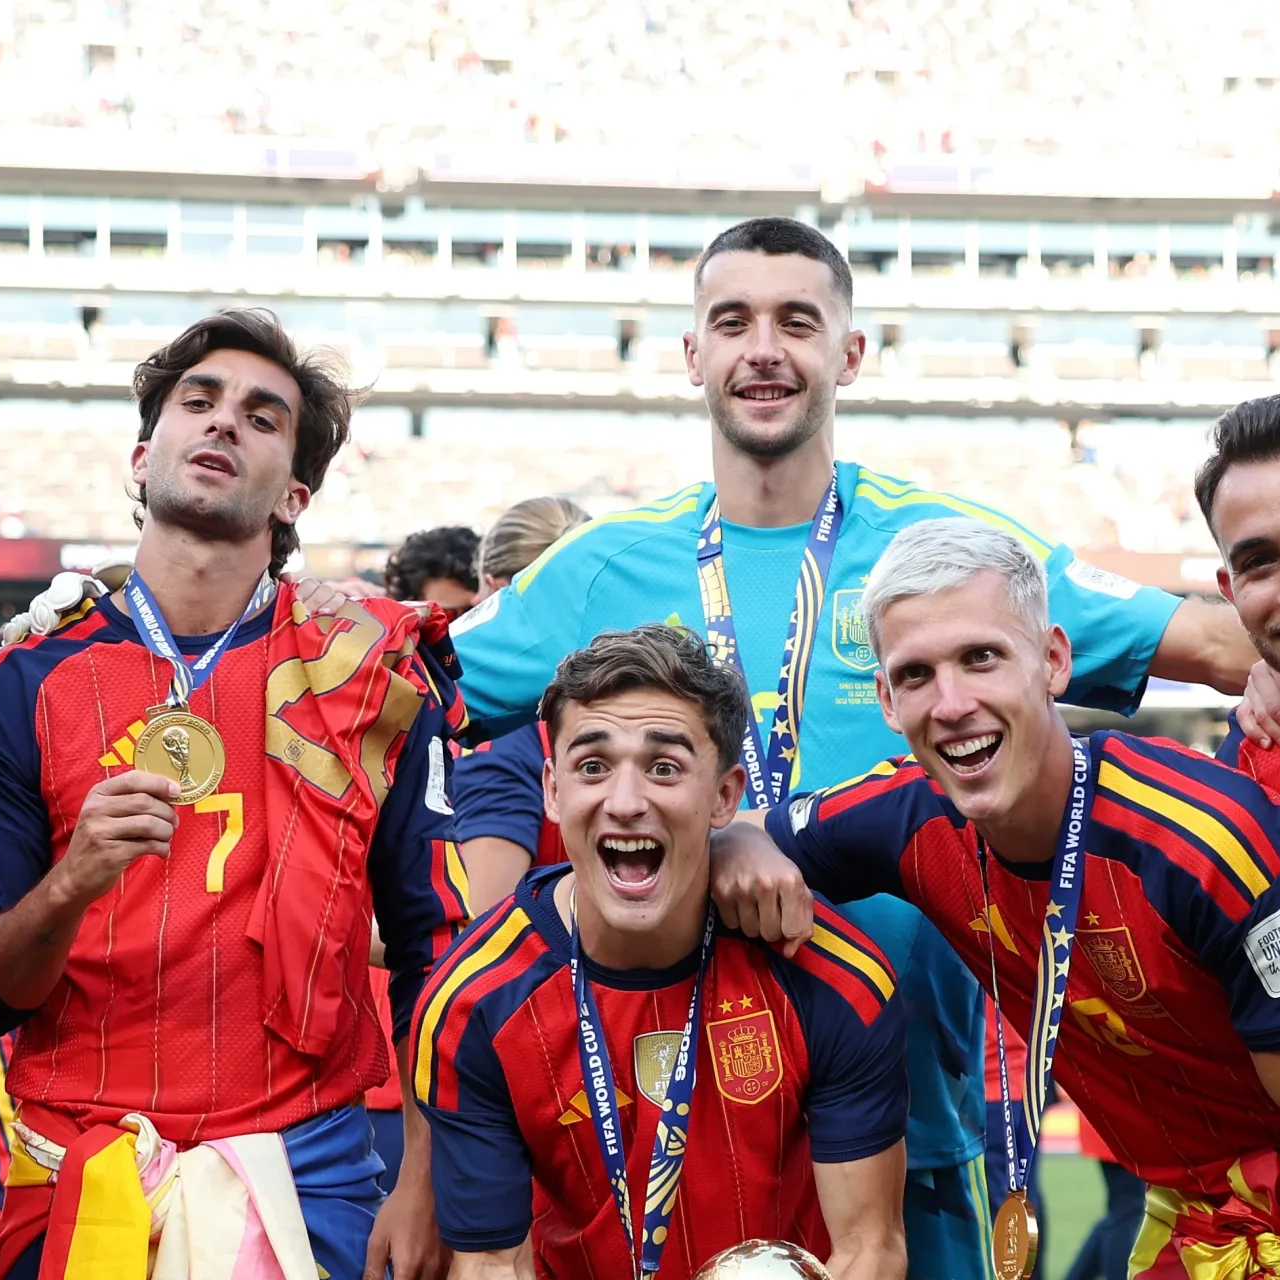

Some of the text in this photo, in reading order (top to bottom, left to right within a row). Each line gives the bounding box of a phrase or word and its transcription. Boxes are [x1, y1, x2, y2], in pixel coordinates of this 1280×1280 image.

[815, 513, 832, 542] FIFA
[131, 586, 144, 607] FIFA
[138, 604, 159, 630] WORLD
[742, 738, 766, 792] WORLD
[1074, 749, 1088, 784] CUP
[1066, 786, 1085, 849] WORLD
[194, 793, 244, 893] 7
[1060, 851, 1077, 889] FIFA
[580, 1020, 598, 1054] CUP
[675, 1022, 693, 1081] 2026
[589, 1055, 612, 1120] WORLD
[1001, 1060, 1011, 1124] WORLD
[602, 1119, 619, 1156] FIFA
